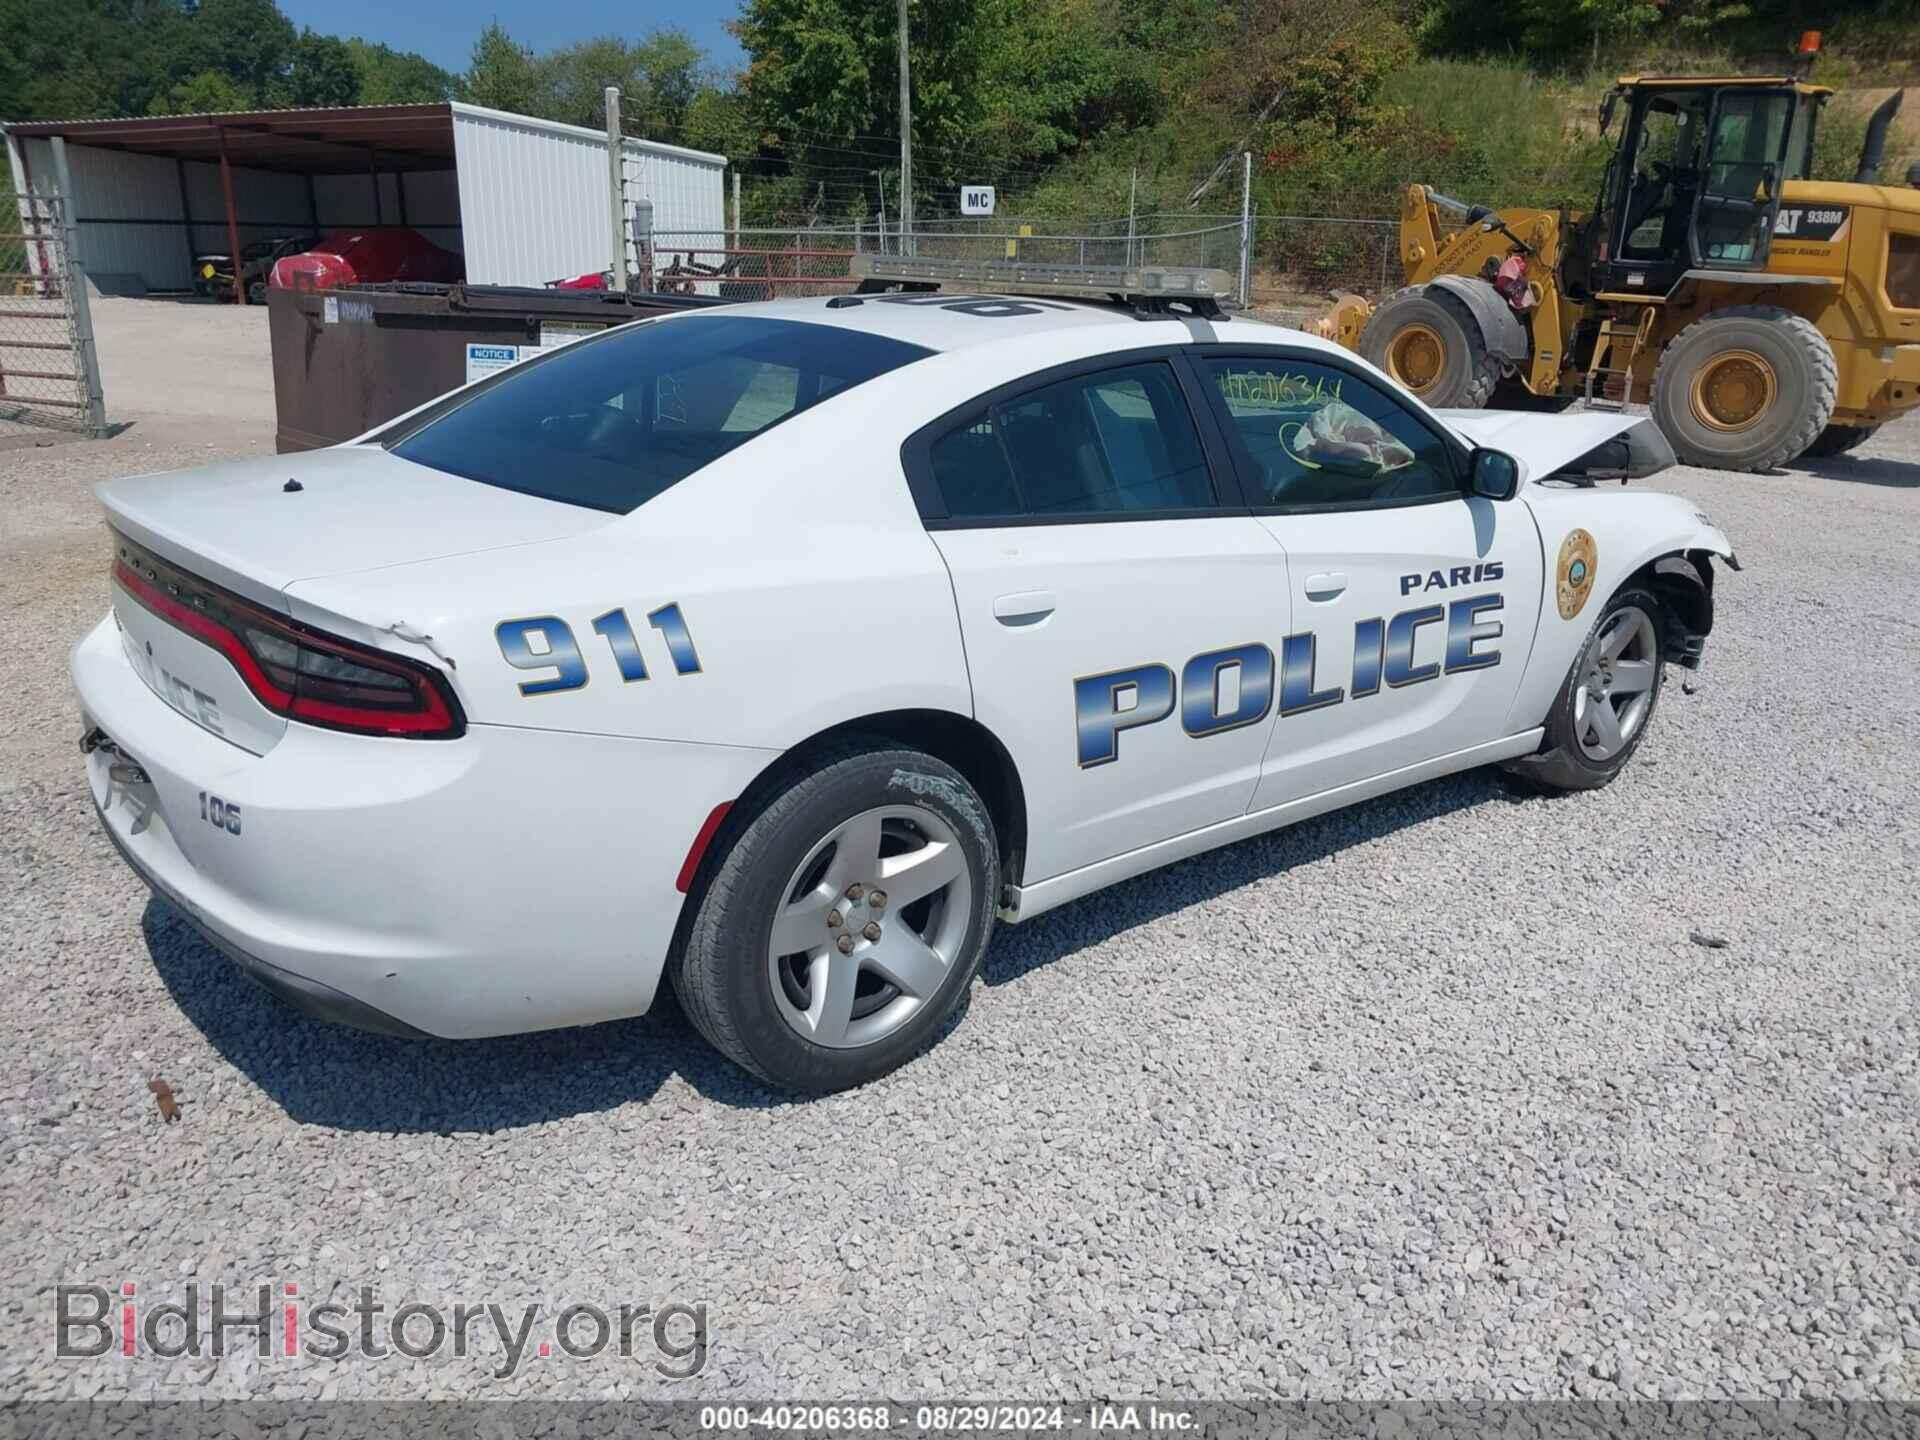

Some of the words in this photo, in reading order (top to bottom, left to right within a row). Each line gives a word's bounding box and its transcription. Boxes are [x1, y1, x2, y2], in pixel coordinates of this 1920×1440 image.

[967, 192, 989, 208] MC
[1807, 210, 1843, 224] 938M
[474, 349, 511, 359] NOTICE
[1400, 561, 1504, 596] PARIS
[494, 601, 702, 697] 911
[1073, 592, 1505, 769] POLICE
[199, 791, 242, 836] 106
